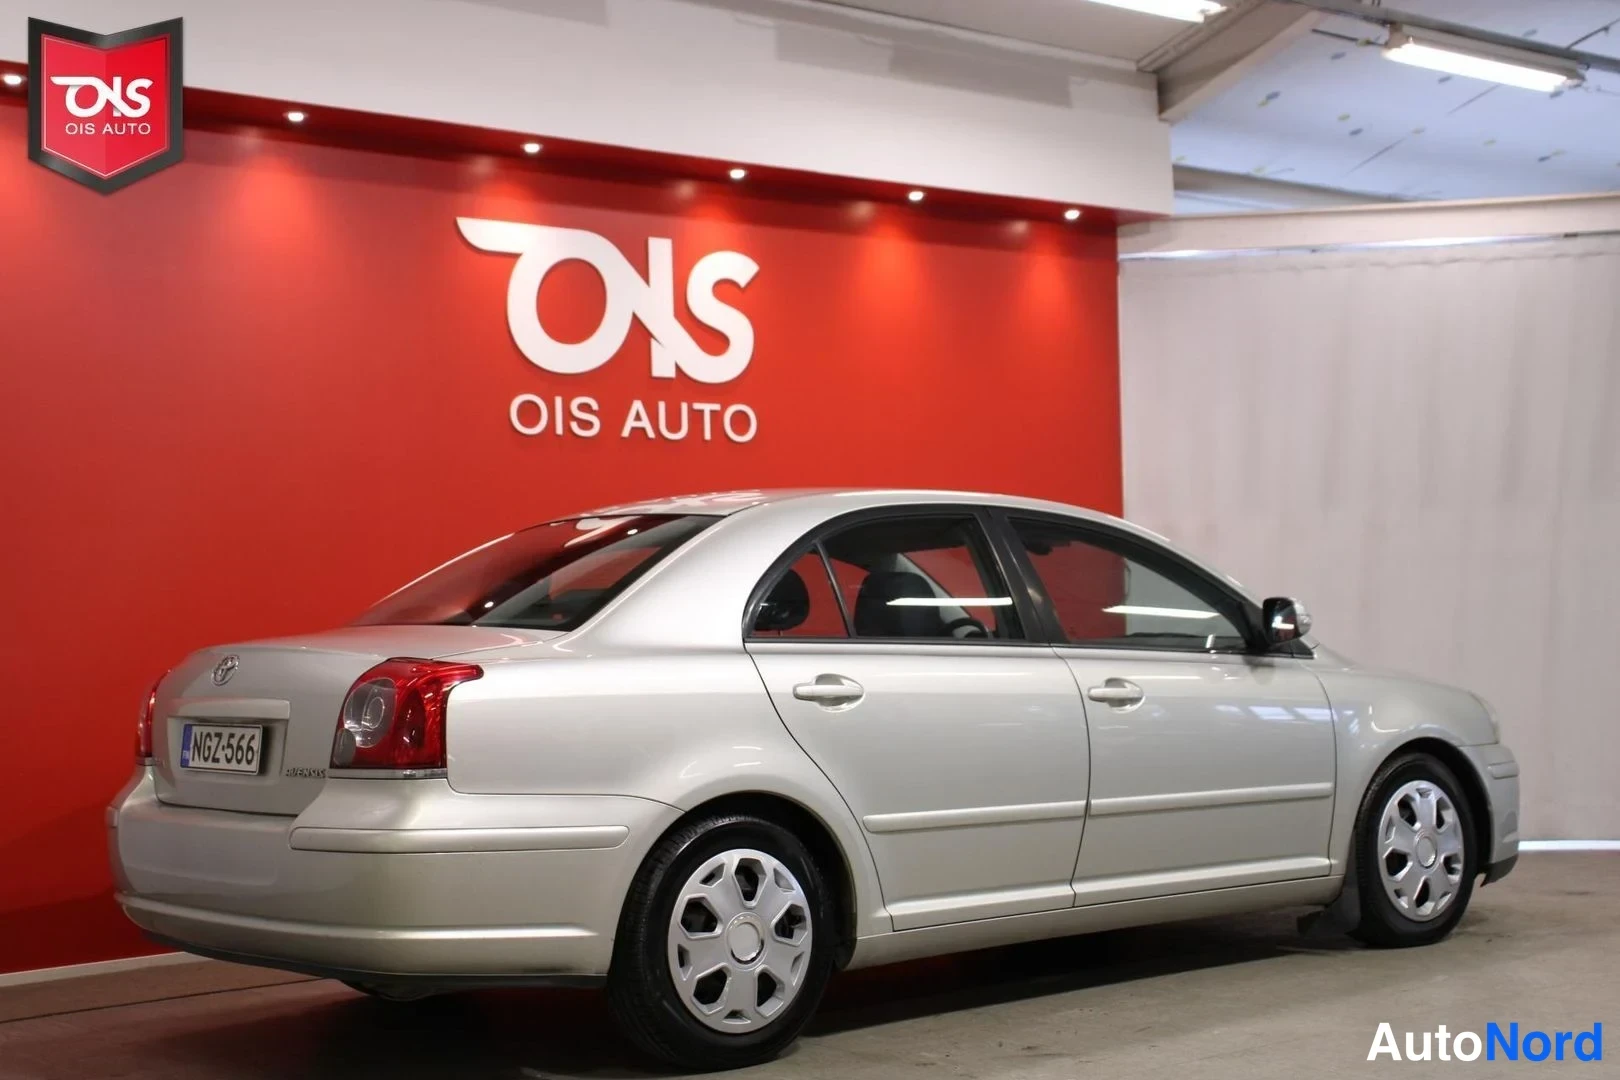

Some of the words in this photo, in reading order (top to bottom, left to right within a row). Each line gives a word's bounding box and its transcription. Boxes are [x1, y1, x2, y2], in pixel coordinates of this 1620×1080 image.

[509, 393, 601, 438] OIS
[620, 399, 758, 443] AUTO
[192, 731, 255, 765] NGZ-566
